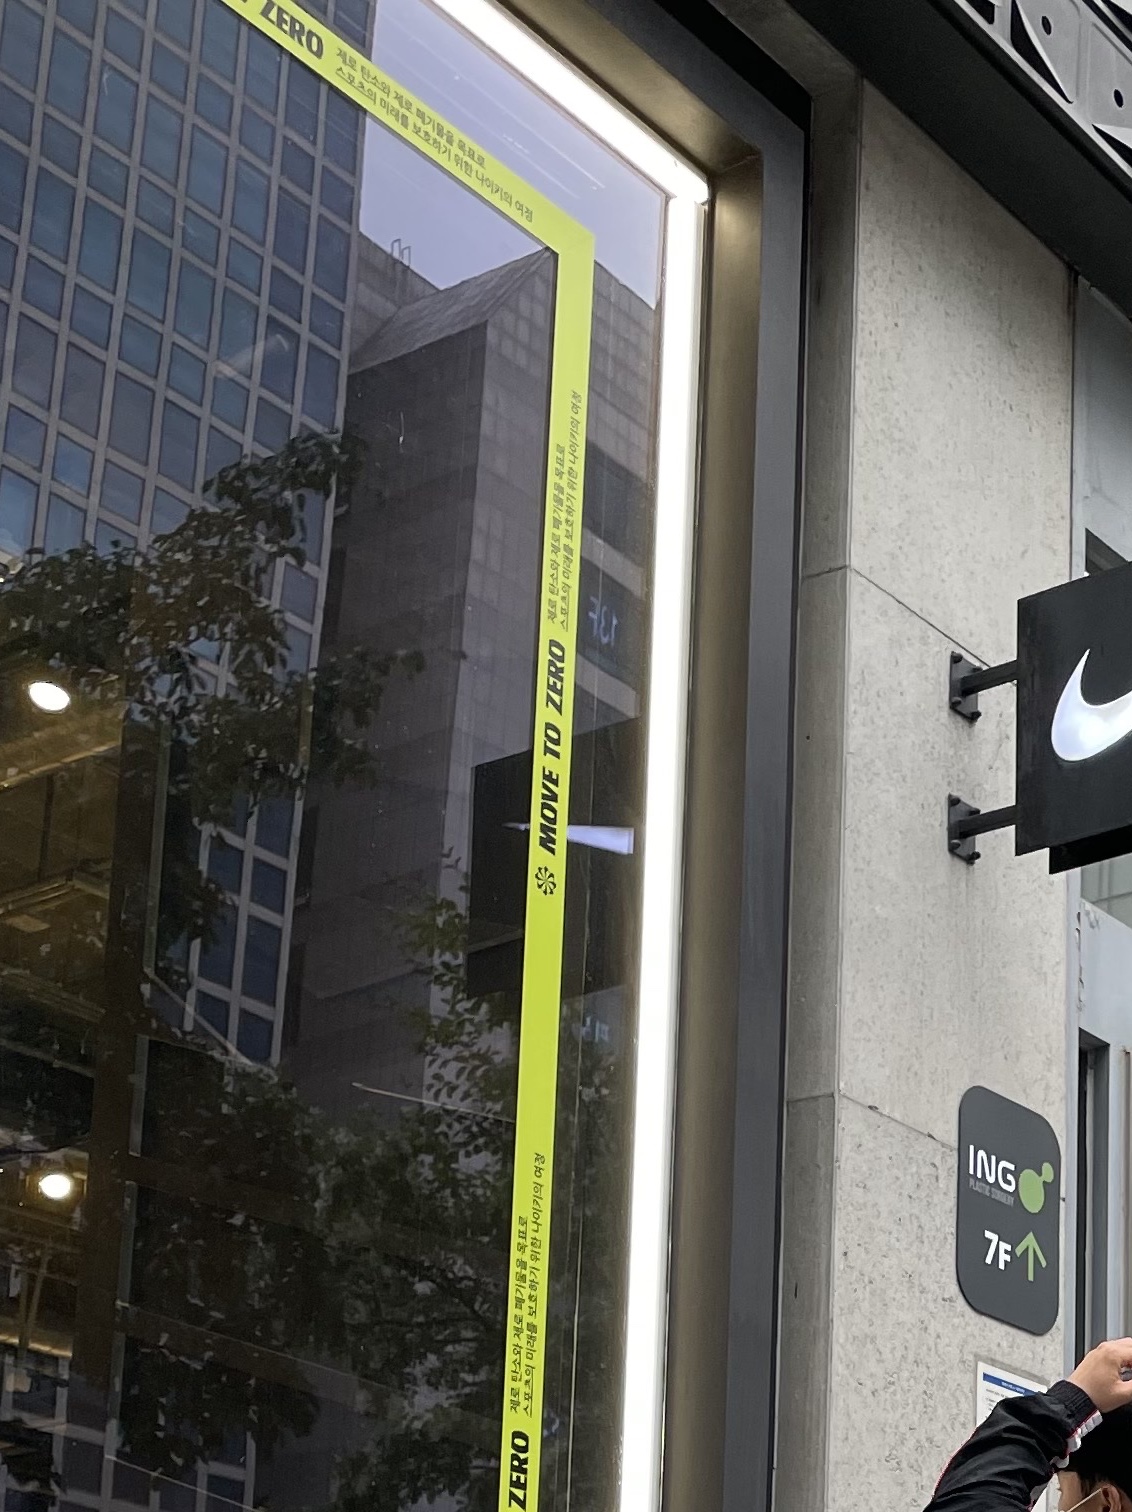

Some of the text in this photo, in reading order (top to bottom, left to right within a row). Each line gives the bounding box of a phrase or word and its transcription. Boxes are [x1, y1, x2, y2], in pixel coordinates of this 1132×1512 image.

[259, 0, 325, 60] ZERO
[539, 638, 566, 855] MOVE TO ZERO
[968, 1144, 1016, 1193] ING
[984, 1229, 1012, 1271] 7F
[508, 1430, 530, 1512] ZERO
